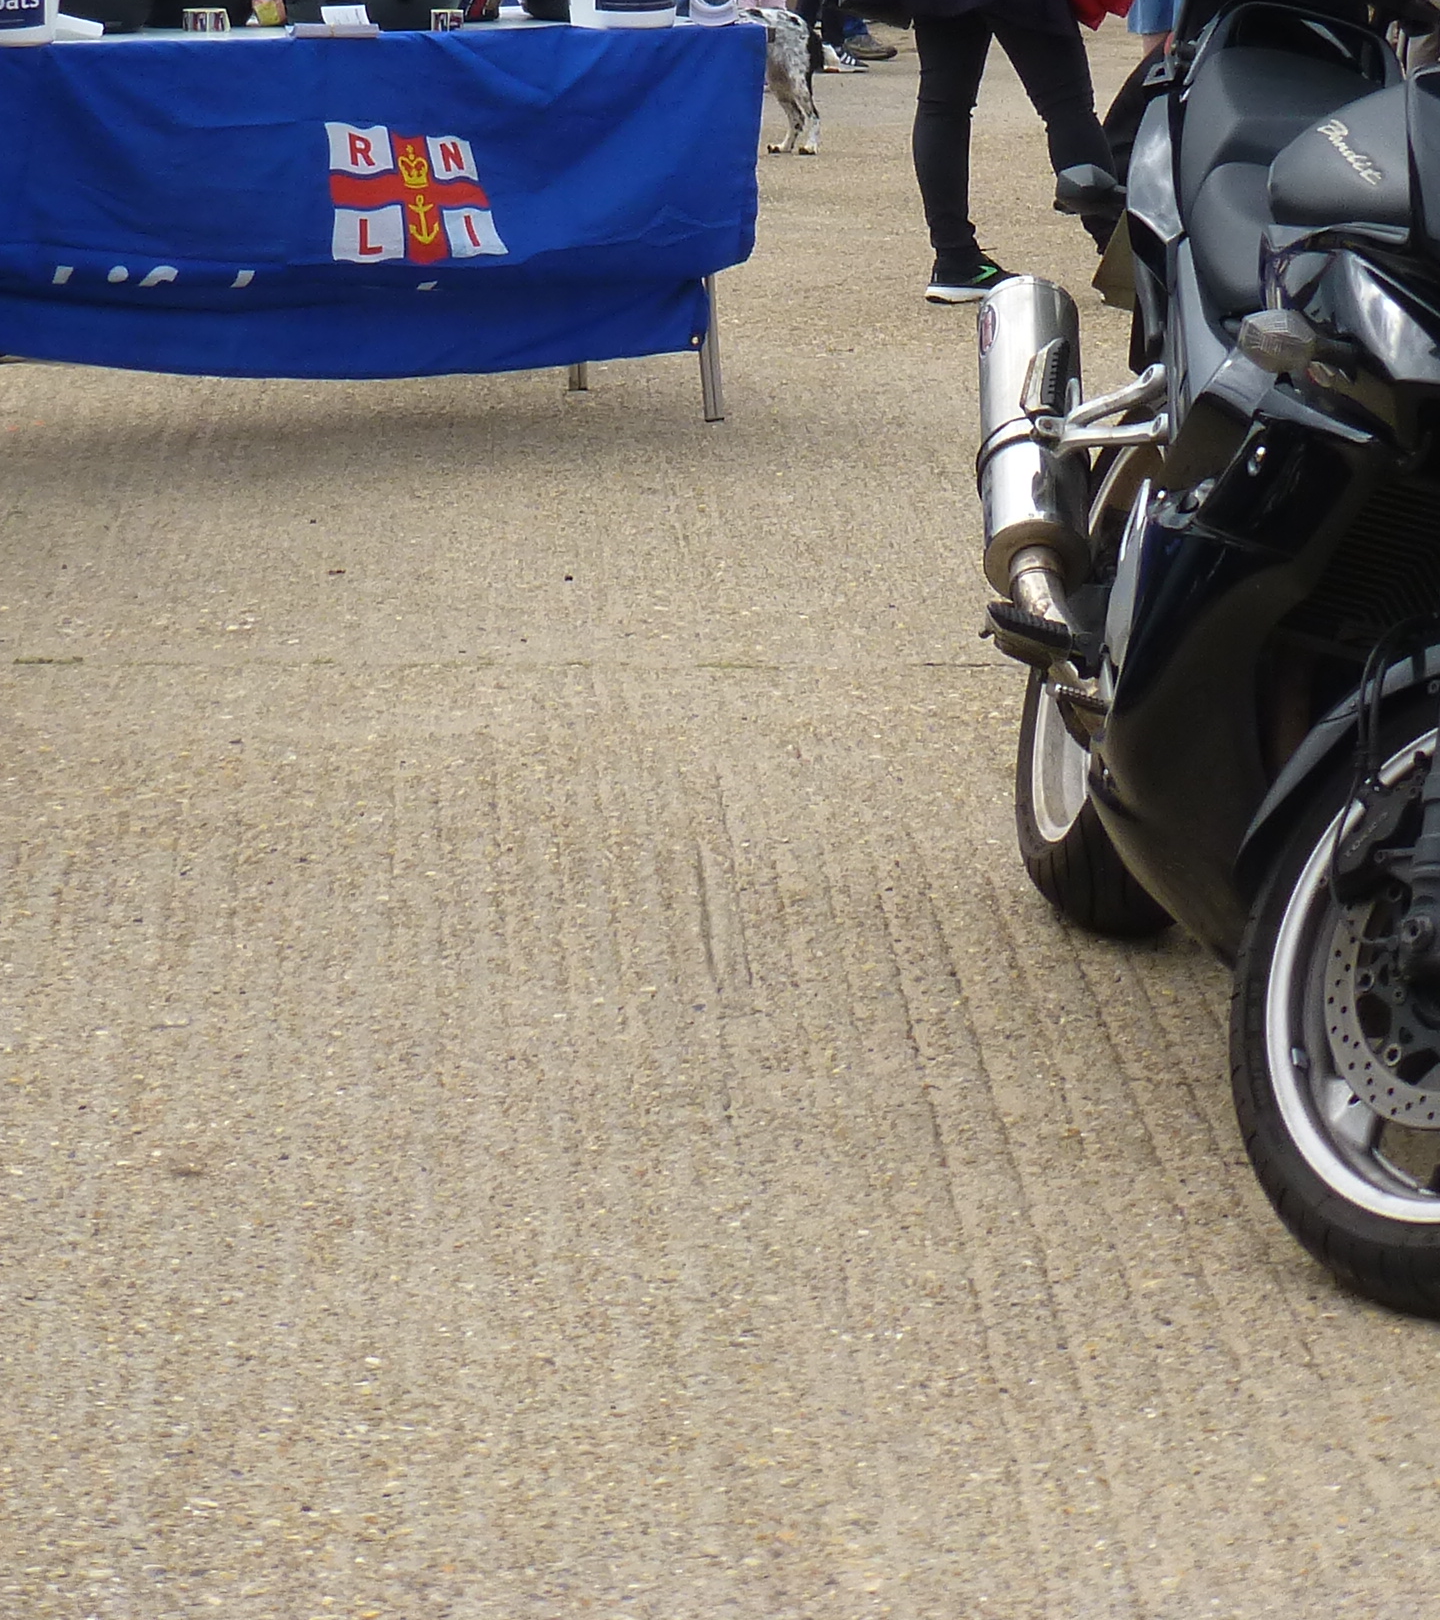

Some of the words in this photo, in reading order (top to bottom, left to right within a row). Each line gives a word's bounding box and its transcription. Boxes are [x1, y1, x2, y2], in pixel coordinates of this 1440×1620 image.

[348, 132, 375, 166] R
[439, 142, 464, 172] N
[1317, 118, 1382, 186] Bandit
[359, 218, 383, 256] L
[463, 214, 483, 248] I
